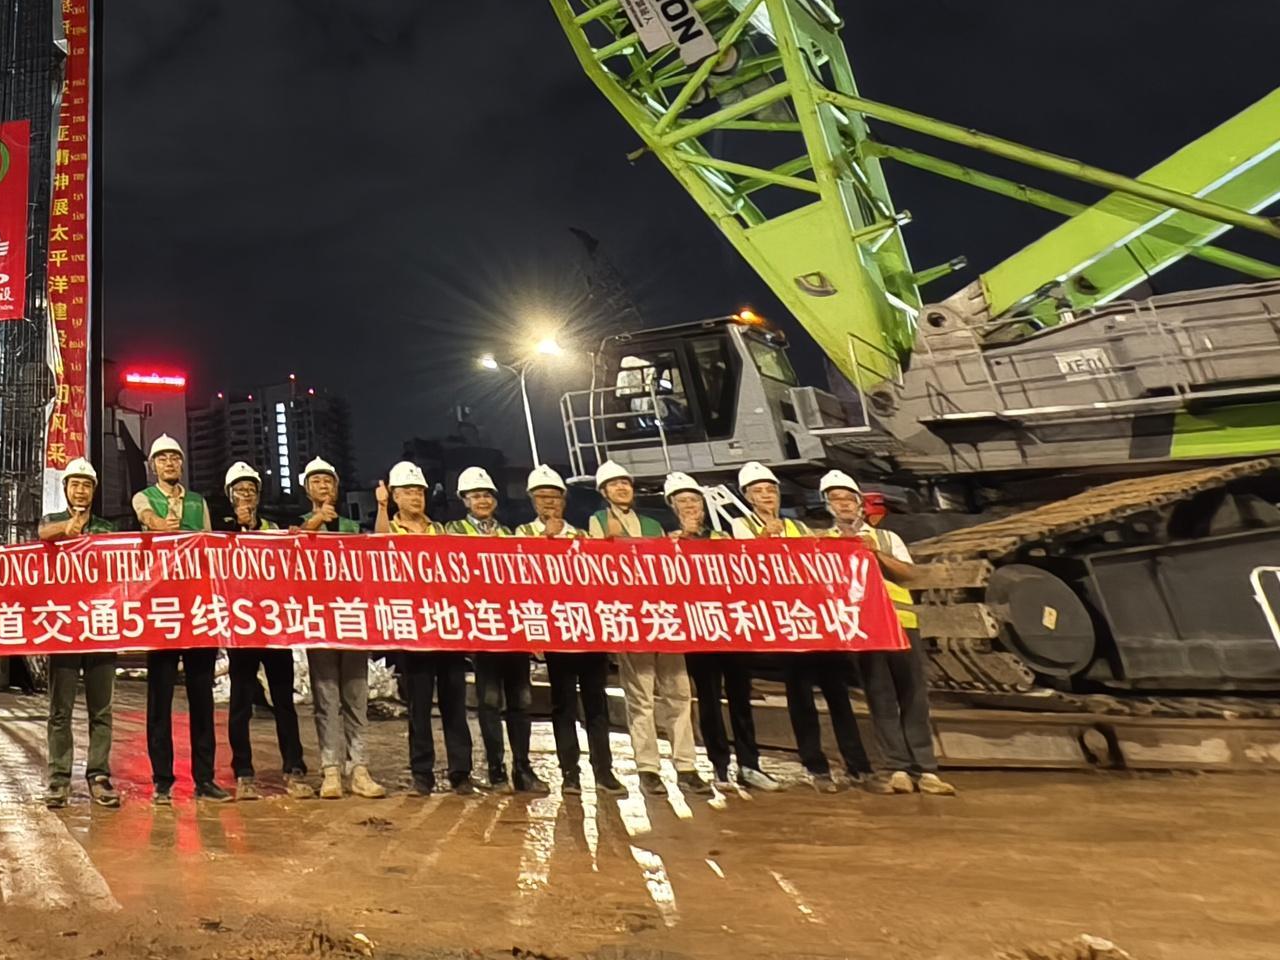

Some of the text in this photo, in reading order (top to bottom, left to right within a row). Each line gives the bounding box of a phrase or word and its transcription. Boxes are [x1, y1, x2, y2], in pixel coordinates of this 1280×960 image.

[278, 539, 319, 582] VÂY
[369, 541, 416, 583] TIÊN
[418, 551, 448, 583] GA
[449, 551, 470, 584] S3
[691, 554, 732, 595] THỊ
[757, 553, 771, 585] 5
[768, 544, 804, 585] HÀ
